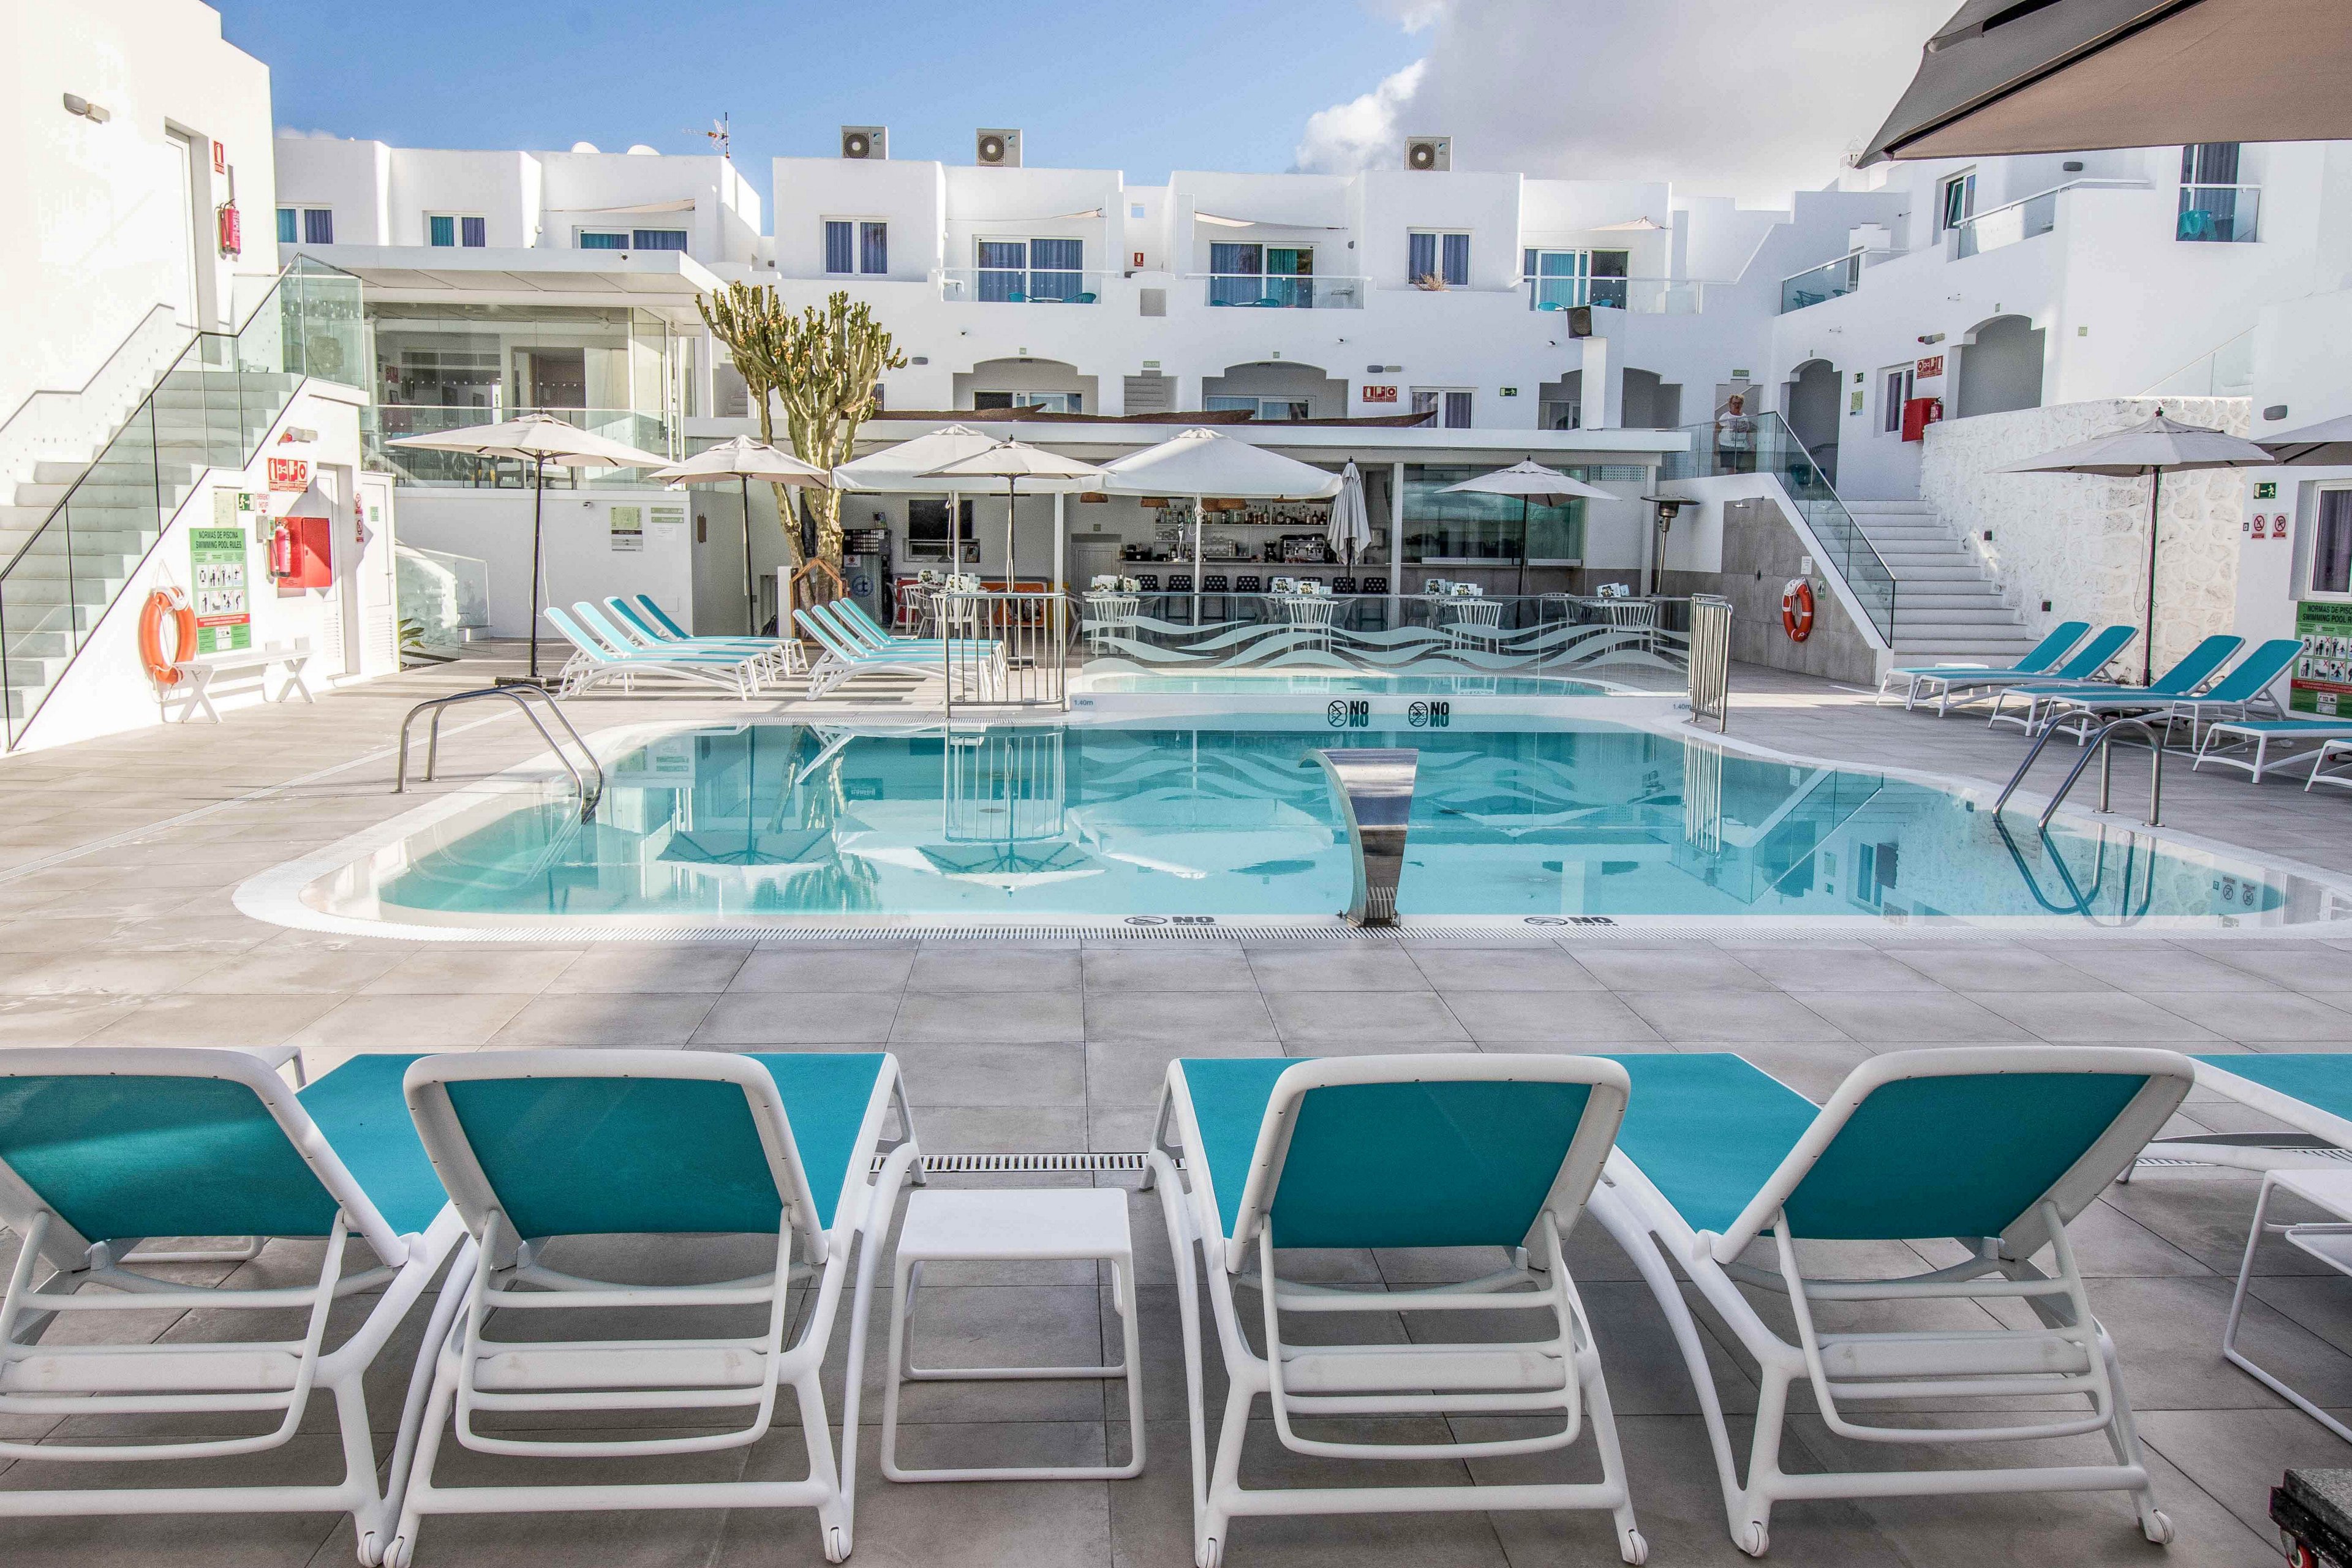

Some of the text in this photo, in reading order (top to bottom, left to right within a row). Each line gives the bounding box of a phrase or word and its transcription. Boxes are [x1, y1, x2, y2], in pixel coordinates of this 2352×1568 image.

[2302, 613, 2330, 622] SWIMMING
[1349, 700, 1370, 715] NO
[1430, 701, 1450, 715] NO
